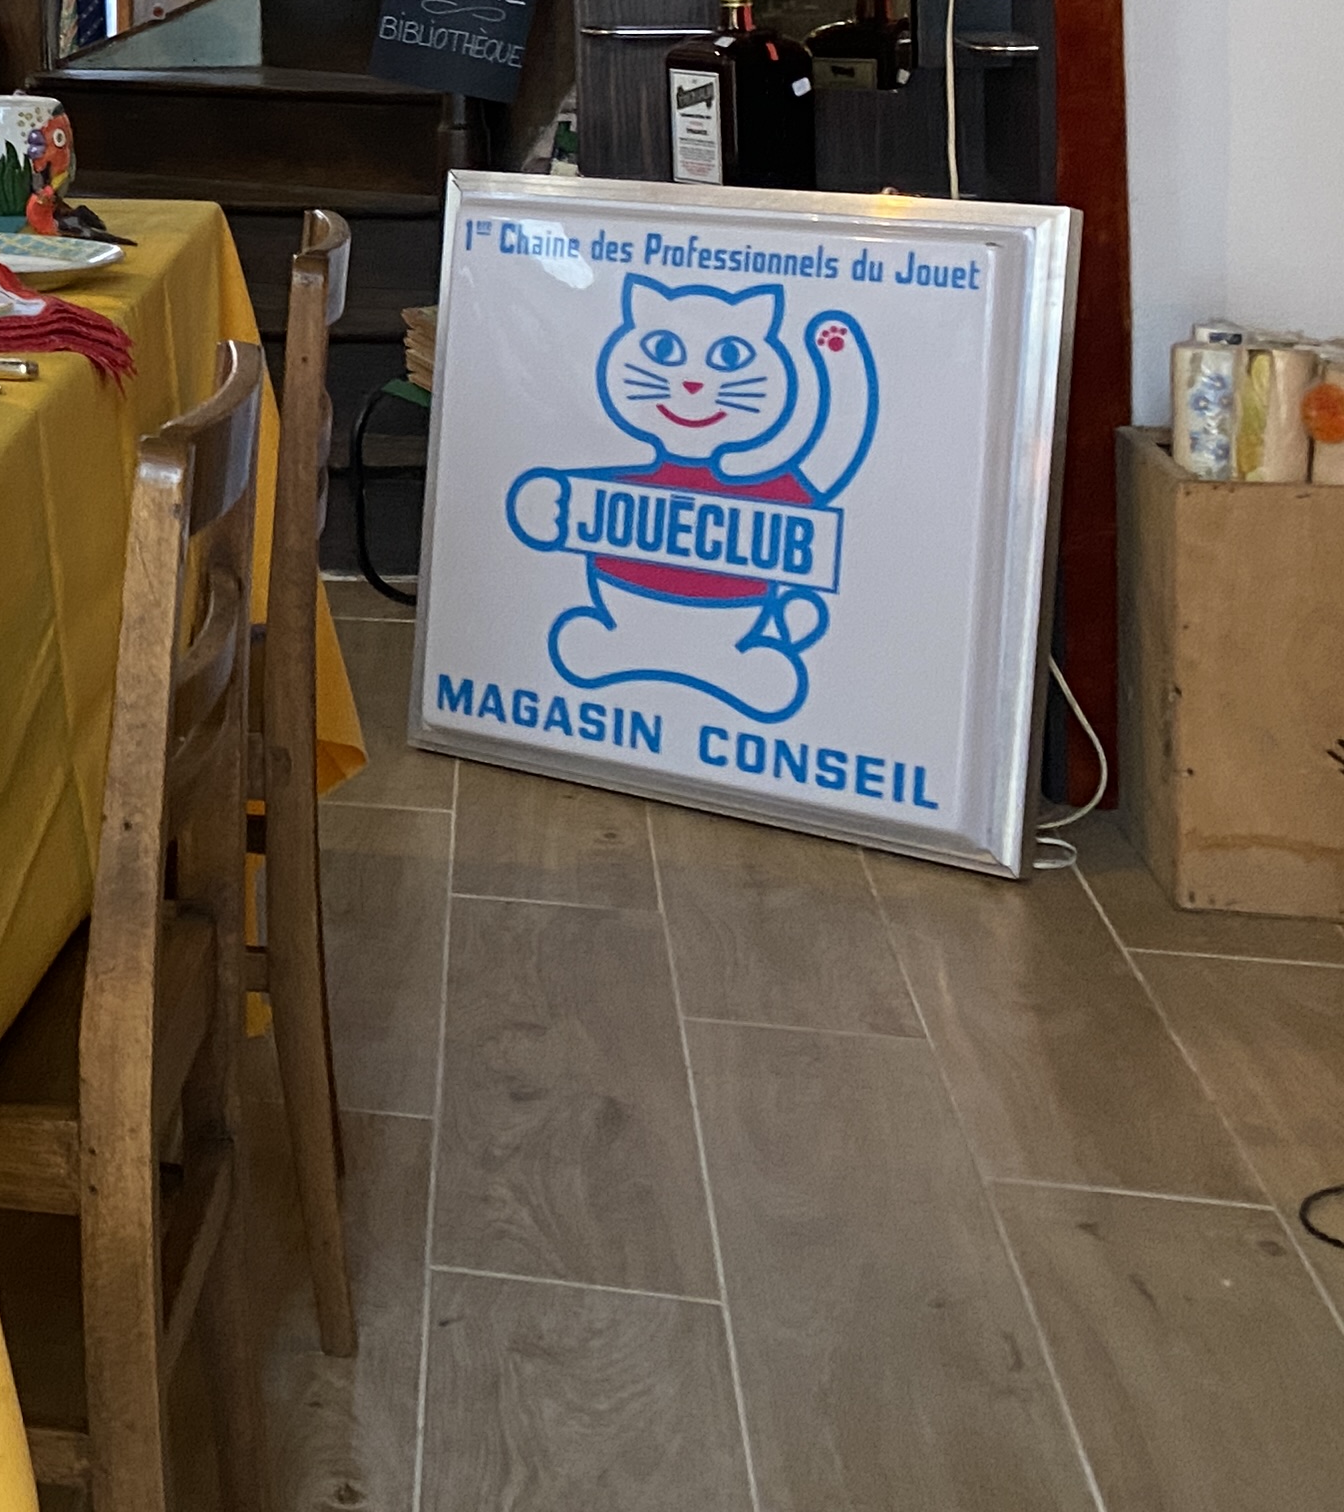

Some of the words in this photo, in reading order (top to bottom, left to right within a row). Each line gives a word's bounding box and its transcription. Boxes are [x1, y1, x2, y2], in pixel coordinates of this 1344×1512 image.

[591, 230, 634, 263] des
[644, 232, 839, 279] Professionnels
[851, 248, 883, 283] du
[895, 251, 981, 290] Jouet
[437, 674, 662, 754] MAGASIN
[699, 725, 939, 811] CONSEIL
